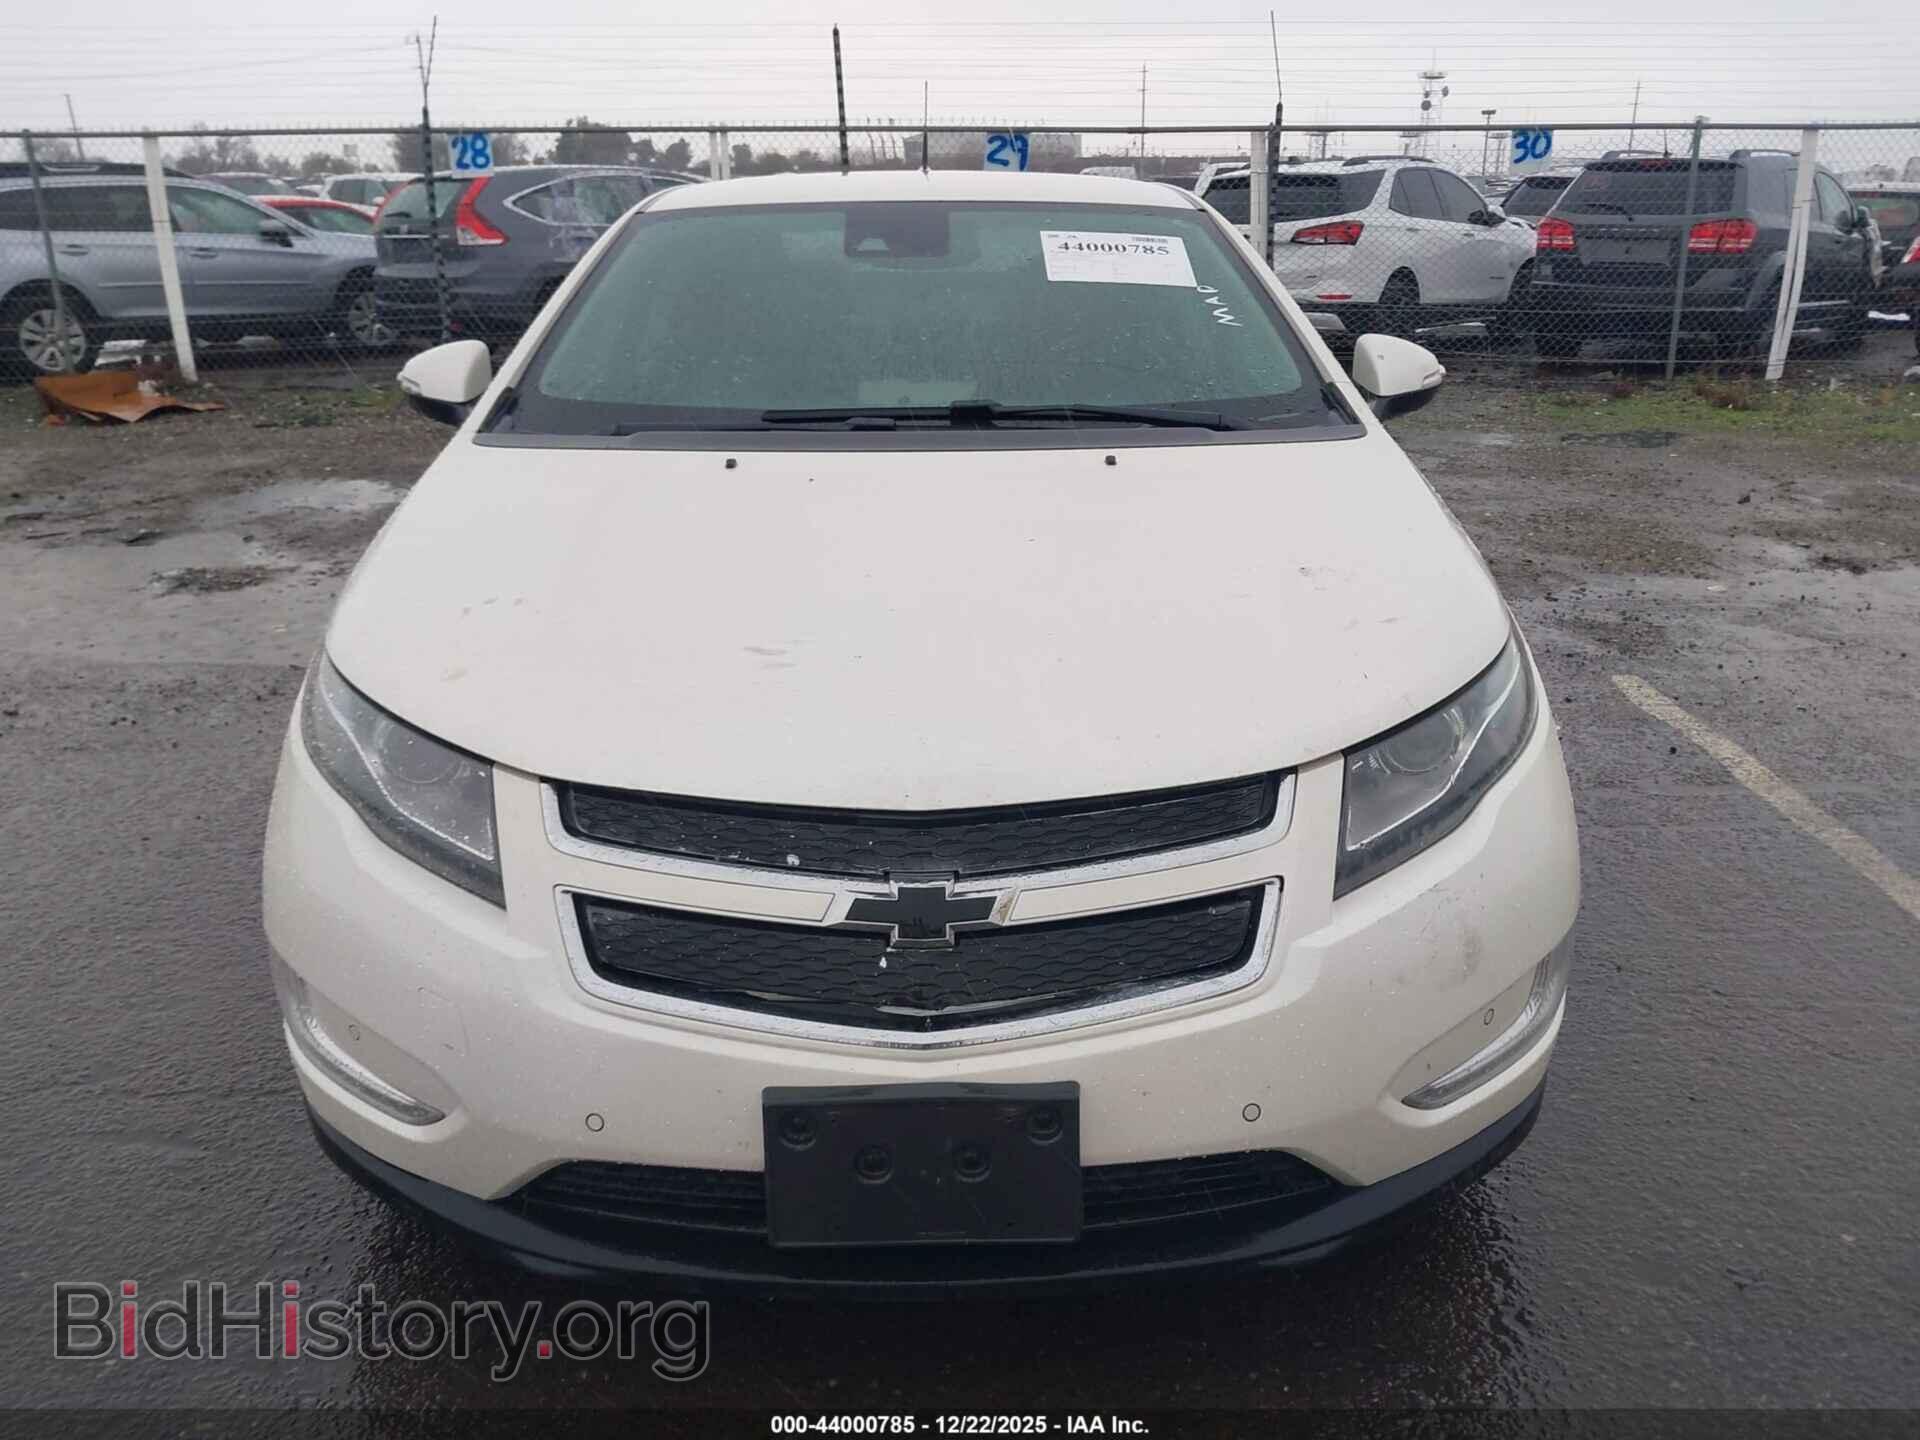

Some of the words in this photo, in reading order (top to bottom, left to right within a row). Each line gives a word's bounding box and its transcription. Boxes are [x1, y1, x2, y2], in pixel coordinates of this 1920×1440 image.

[451, 132, 491, 169] 28
[987, 134, 1028, 171] 29
[1512, 130, 1552, 164] 30
[1057, 241, 1170, 256] 44000785
